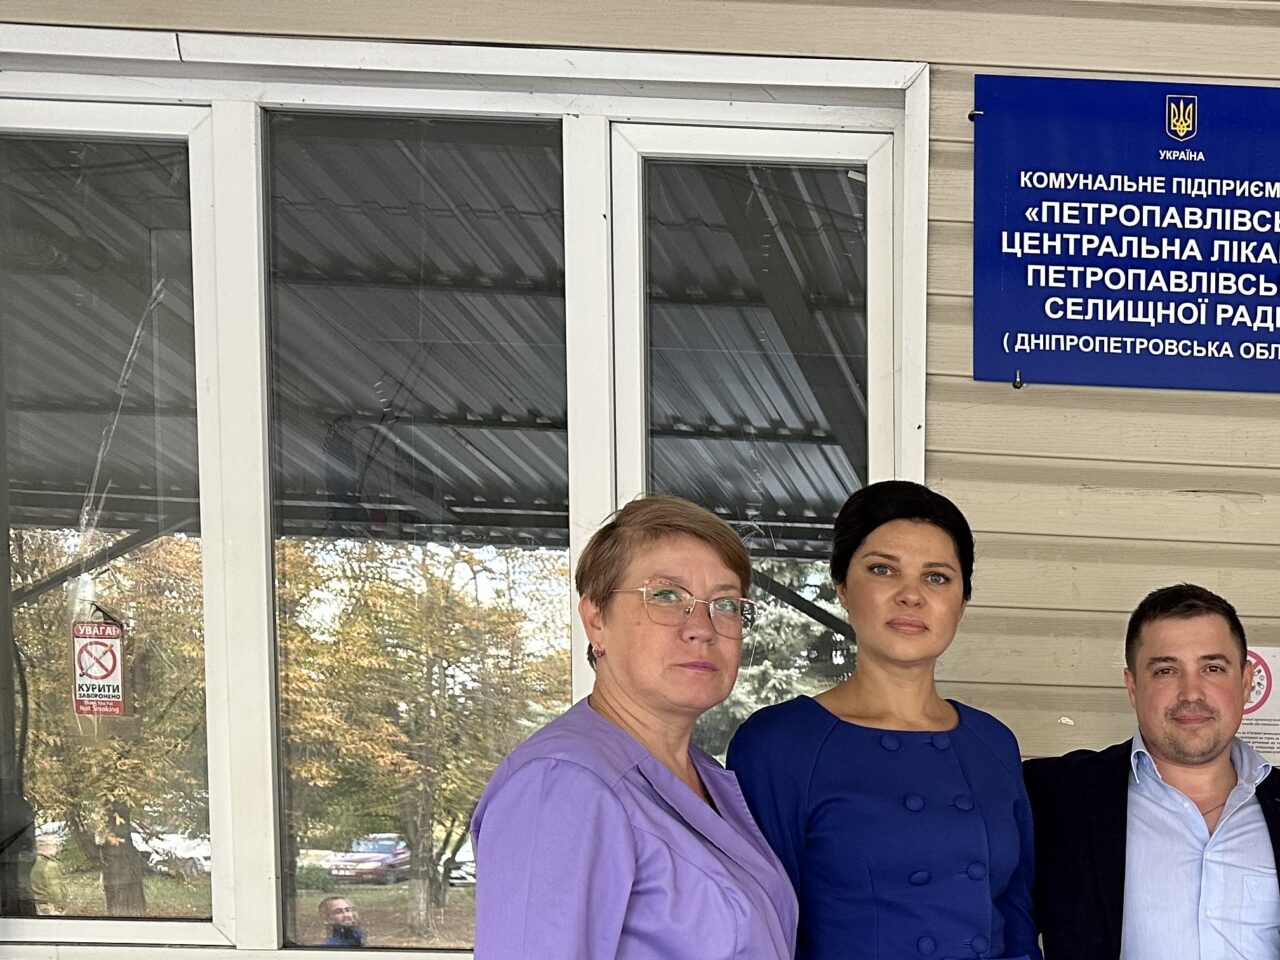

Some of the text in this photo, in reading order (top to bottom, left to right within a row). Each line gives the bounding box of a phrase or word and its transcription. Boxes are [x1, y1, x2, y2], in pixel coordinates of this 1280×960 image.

[1158, 149, 1206, 162] УКРАЇНА
[1020, 170, 1166, 194] КОМУНАЛЬНЕ
[1001, 230, 1203, 261] ЦЕНТРАЛЬНА
[1044, 296, 1210, 328] СЕЛИЩНОЇ
[78, 625, 116, 636] УВАГА!
[78, 683, 120, 693] КУРИТИ
[92, 705, 120, 715] Smoking
